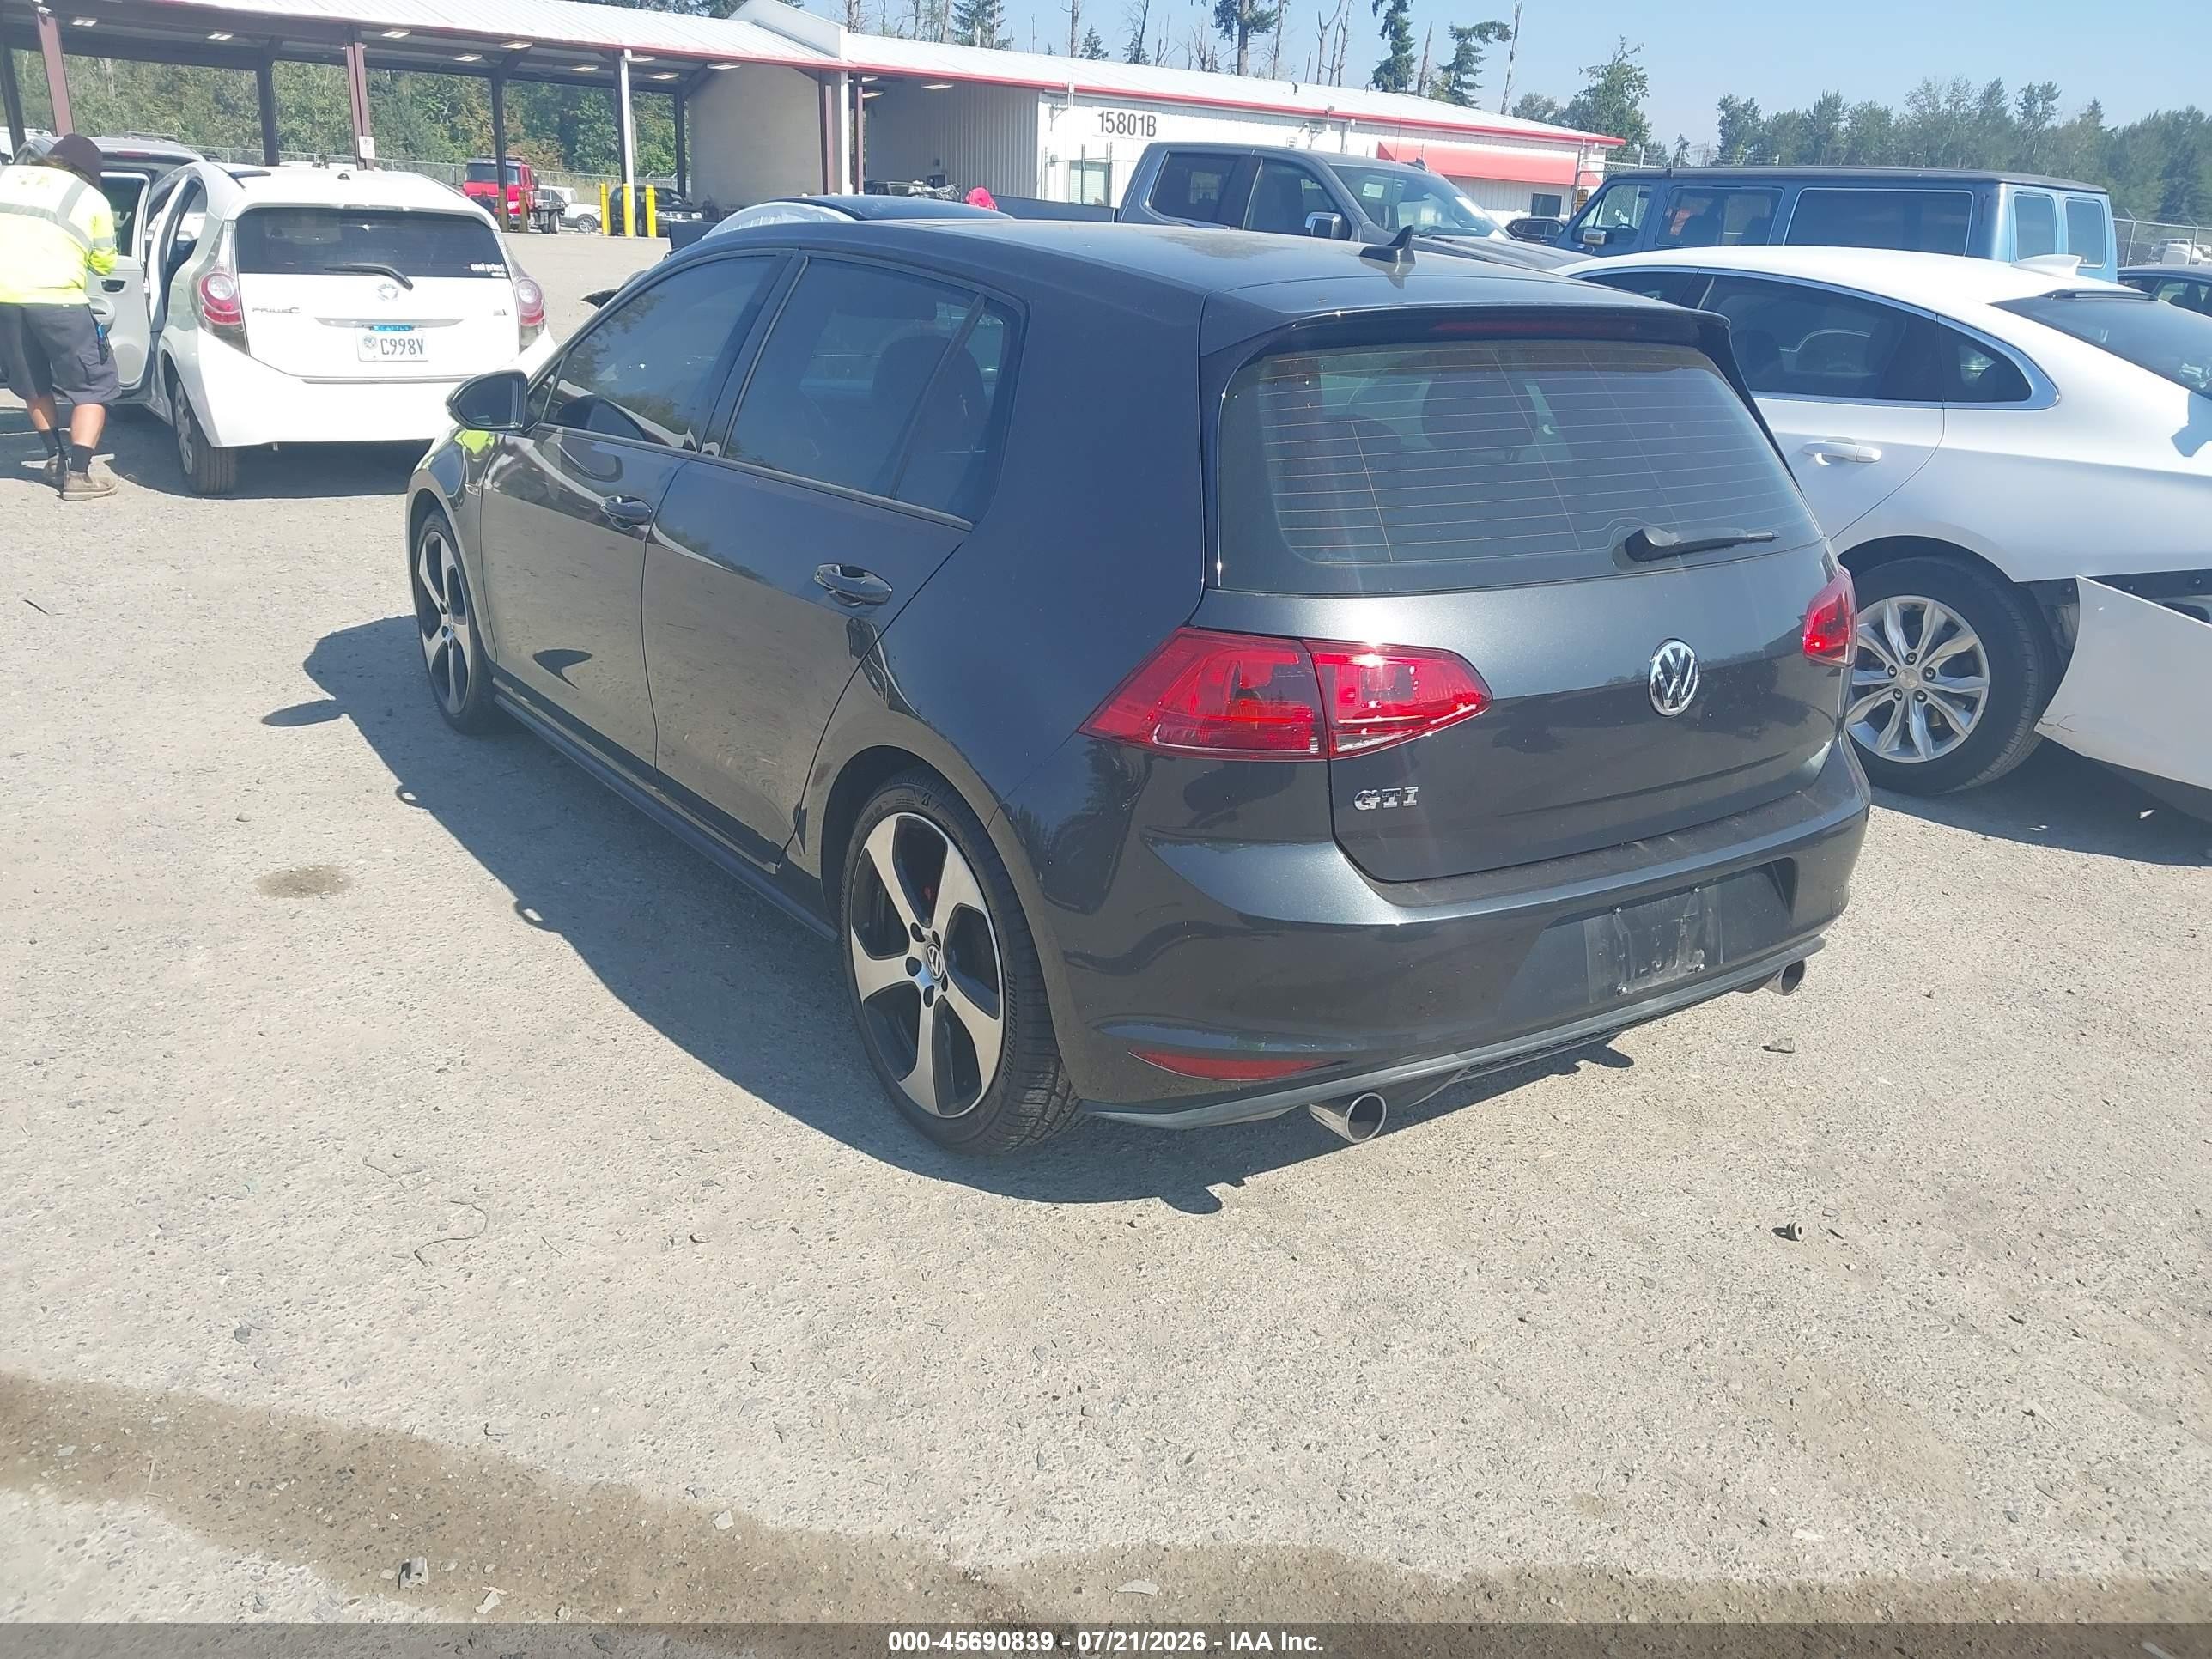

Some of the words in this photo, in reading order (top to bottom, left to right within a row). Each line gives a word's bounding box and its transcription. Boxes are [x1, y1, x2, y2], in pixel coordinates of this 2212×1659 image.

[1097, 110, 1157, 137] 15801B
[380, 337, 424, 356] C998V
[1353, 786, 1419, 811] GTI
